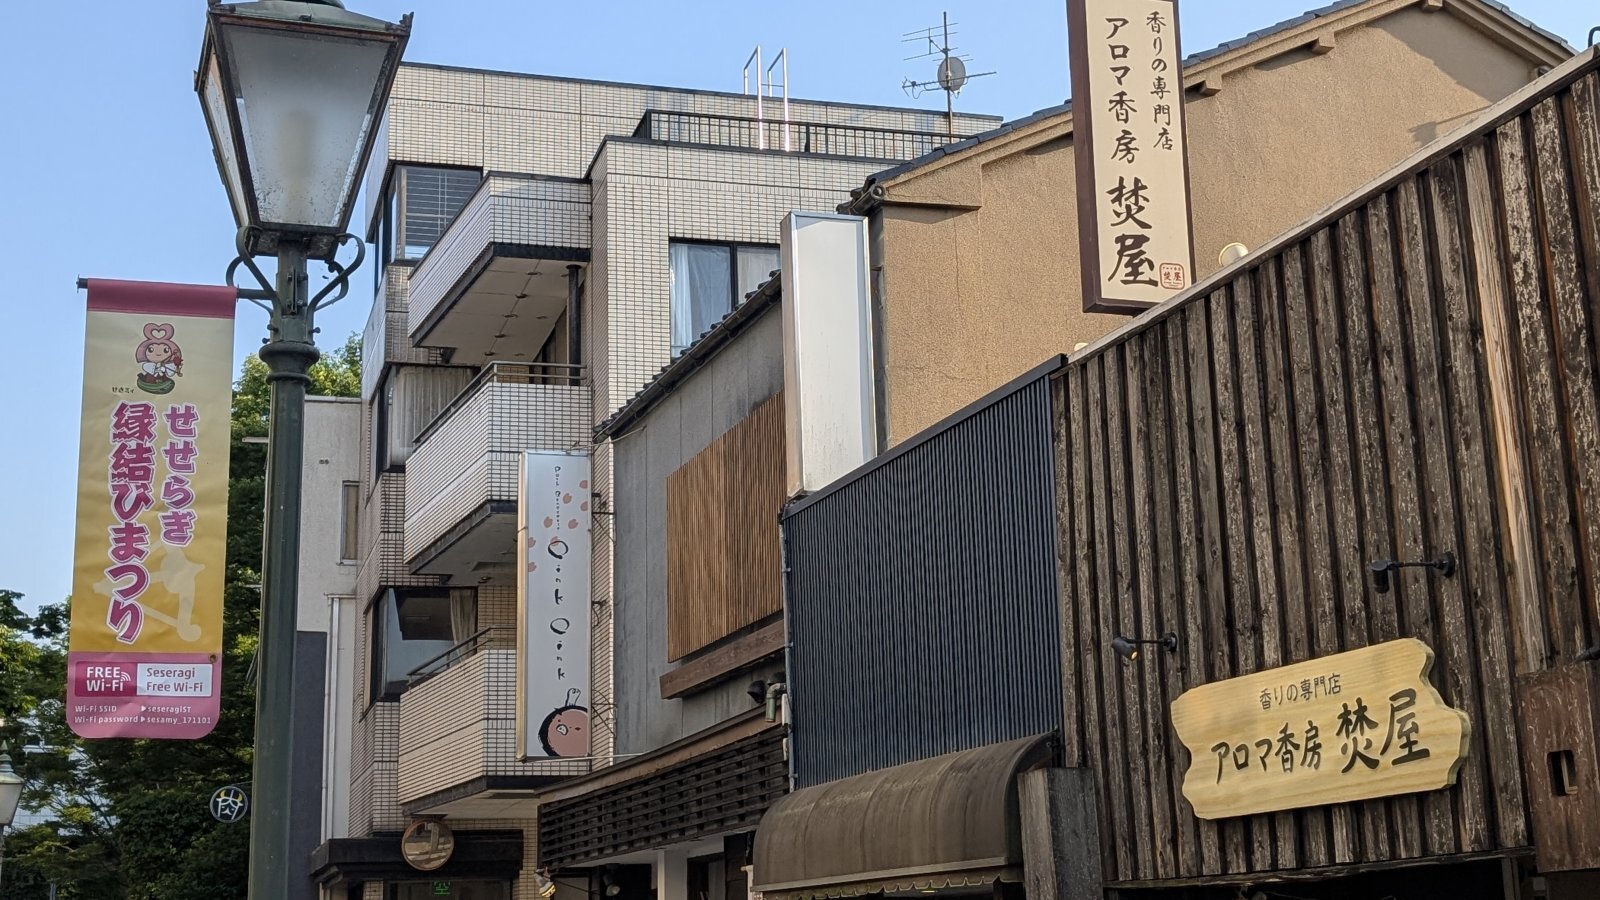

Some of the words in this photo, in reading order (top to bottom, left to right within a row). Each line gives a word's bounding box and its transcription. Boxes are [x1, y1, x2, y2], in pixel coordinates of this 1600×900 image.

[1105, 17, 1139, 164] アロマ香房
[1146, 11, 1173, 151] 香りの専門店
[159, 404, 199, 546] せせらぎ
[104, 402, 157, 644] 縁結びまつり
[86, 666, 121, 678] FREE
[146, 667, 196, 680] Seseragi
[550, 617, 570, 680] Oink
[86, 679, 123, 692] Wi-Fi
[146, 682, 171, 692] Free
[173, 682, 203, 693] Wi-Fi
[1259, 673, 1341, 710] 香りの専門店
[98, 716, 138, 725] password
[1210, 720, 1322, 784] アロマ香房
